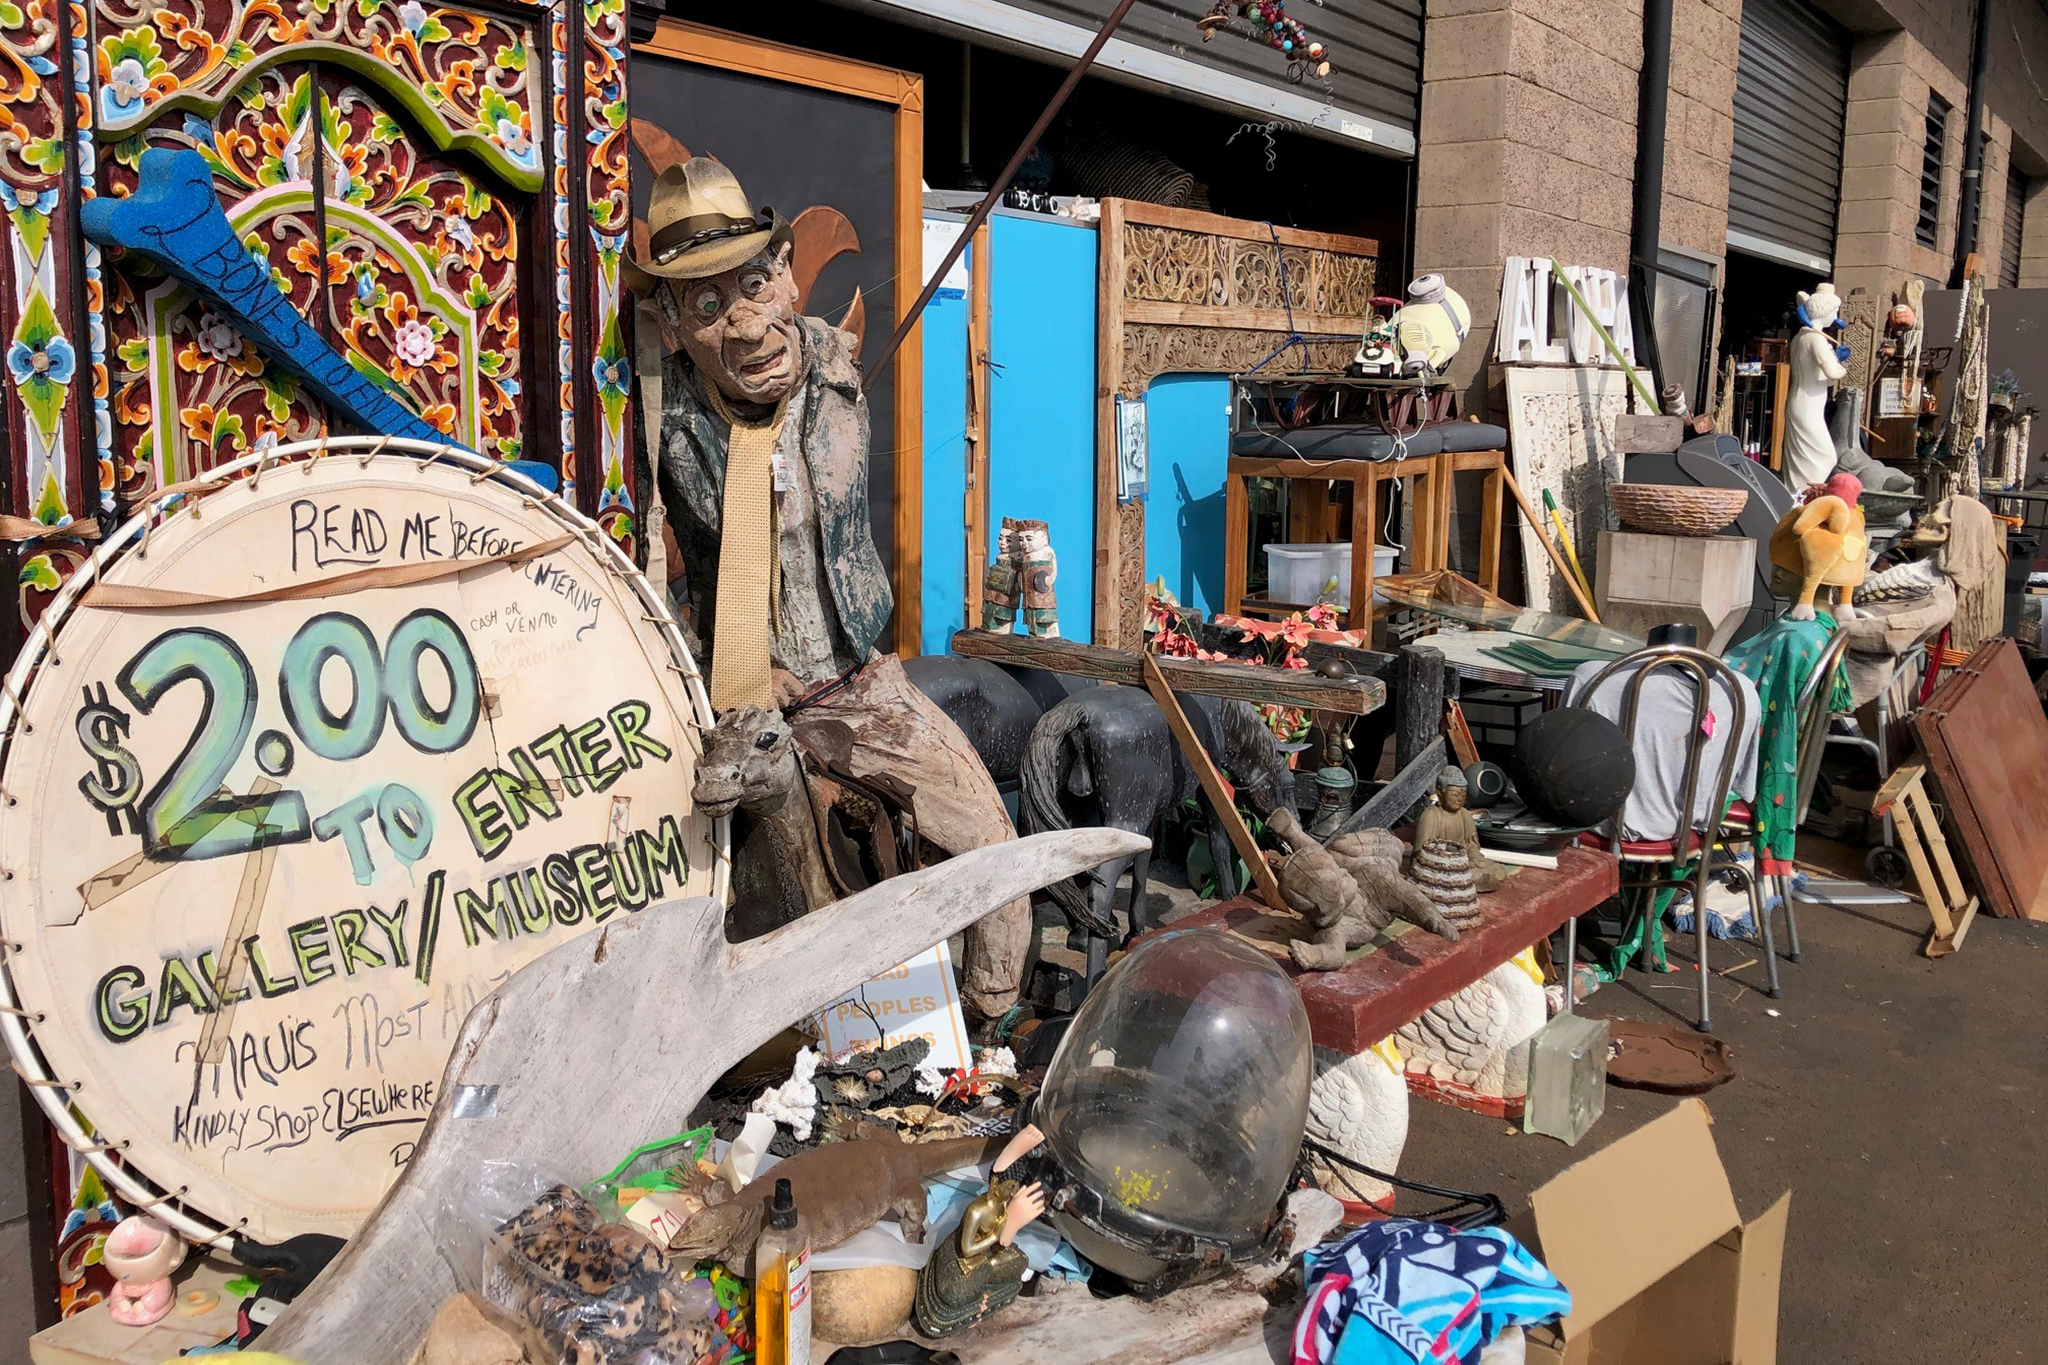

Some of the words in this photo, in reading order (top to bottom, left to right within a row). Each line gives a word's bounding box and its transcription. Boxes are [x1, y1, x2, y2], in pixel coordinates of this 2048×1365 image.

[192, 234, 313, 350] BONES
[304, 337, 356, 387] TO
[291, 499, 389, 575] READ
[400, 512, 443, 561] ME
[470, 609, 498, 631] CASH
[505, 601, 521, 616] OR
[75, 608, 479, 863] $2.00
[312, 782, 434, 887] TO
[452, 699, 673, 862] ENTER
[836, 995, 937, 1022] PEOPLES
[172, 1104, 250, 1171] KINDLY
